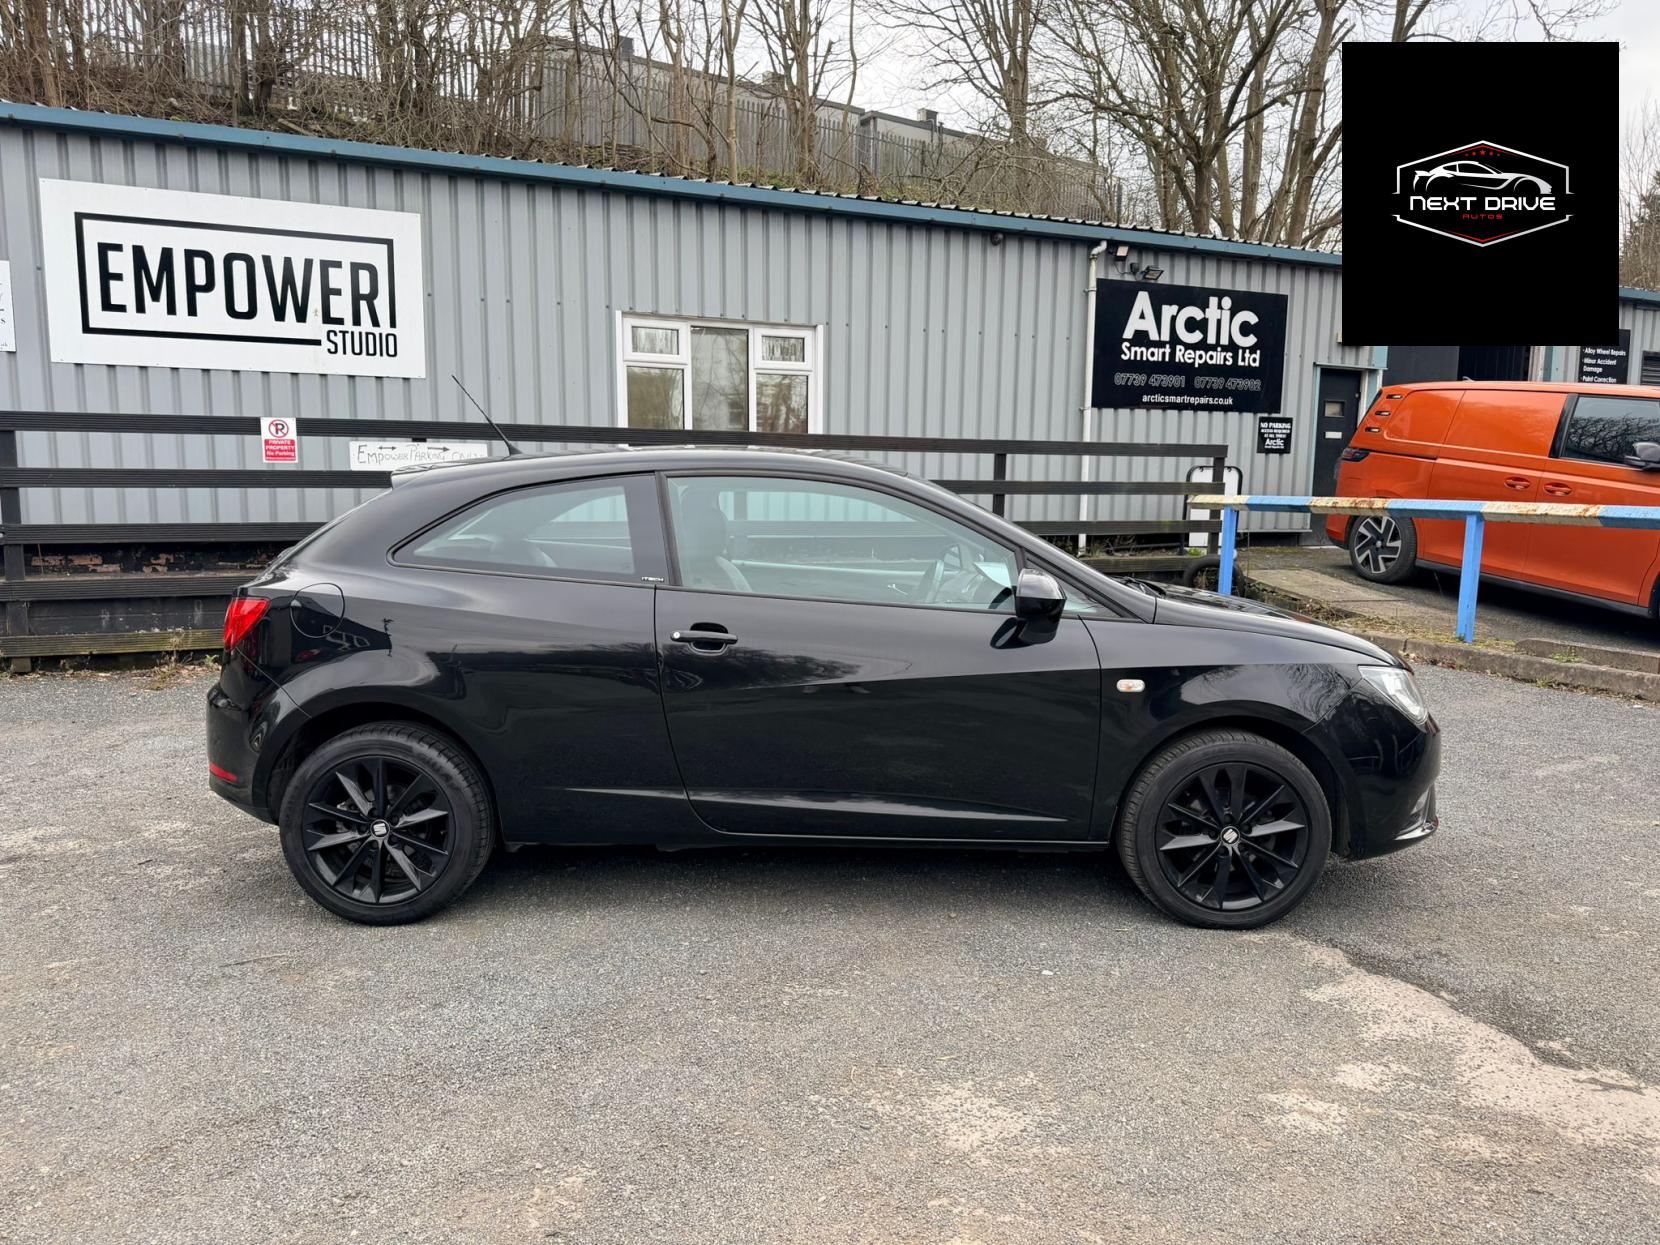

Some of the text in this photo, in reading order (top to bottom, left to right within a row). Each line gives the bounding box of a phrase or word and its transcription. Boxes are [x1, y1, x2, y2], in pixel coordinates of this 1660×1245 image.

[97, 241, 381, 328] EMPOWER
[1122, 290, 1260, 348] Arctic
[326, 329, 398, 358] STUDIO
[1121, 341, 1261, 368] Smart Repairs Ltd
[1585, 347, 1596, 355] Alloy
[1142, 393, 1233, 406] arcticsmartrepairs.co.uk
